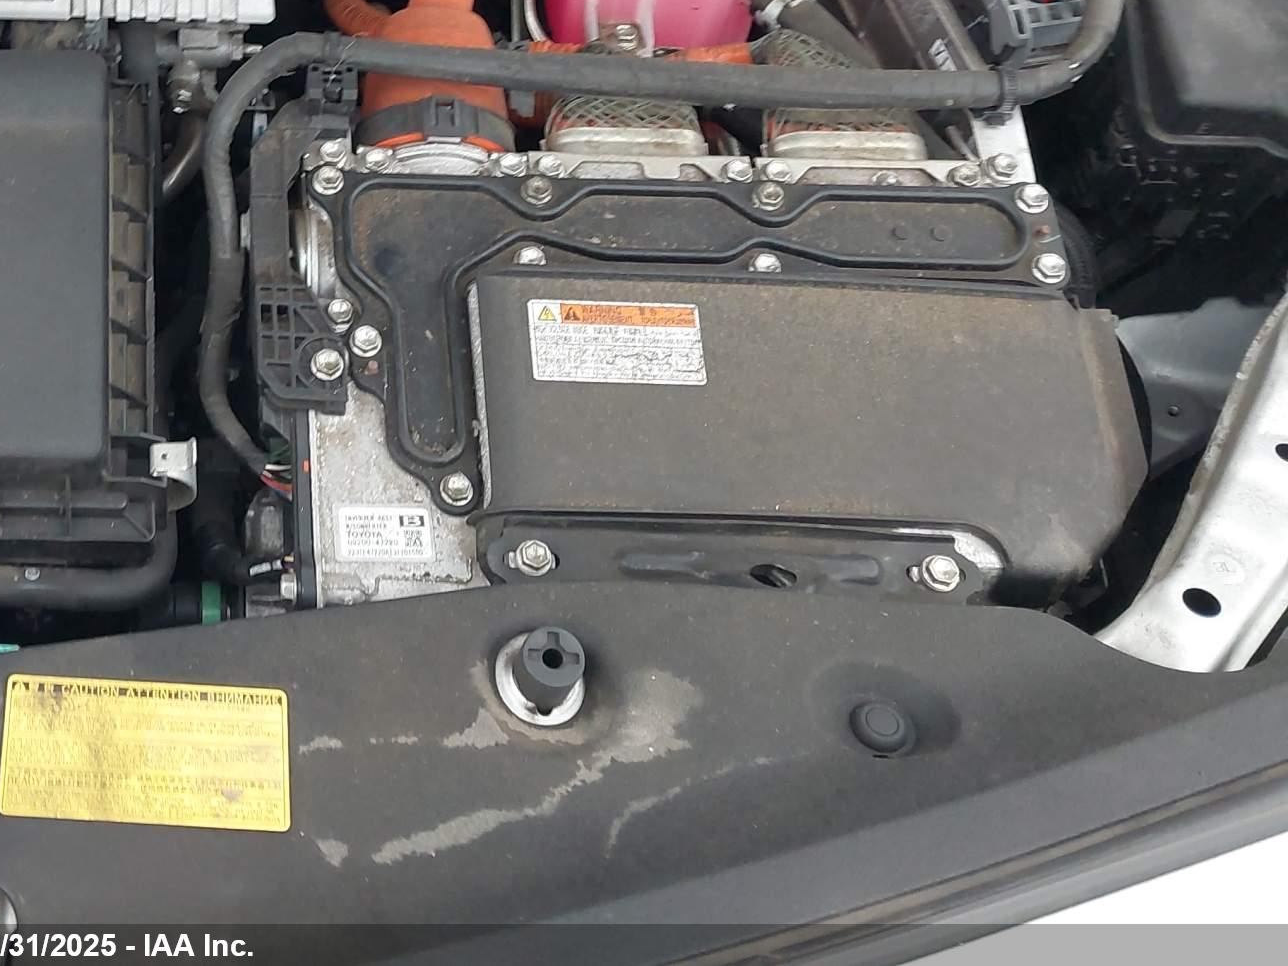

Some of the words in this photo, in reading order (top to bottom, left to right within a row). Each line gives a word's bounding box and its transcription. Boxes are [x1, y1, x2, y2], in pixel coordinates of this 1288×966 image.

[347, 529, 383, 538] TOYOTA
[62, 684, 120, 697] CAUTION
[126, 687, 200, 702] ATTENTION
